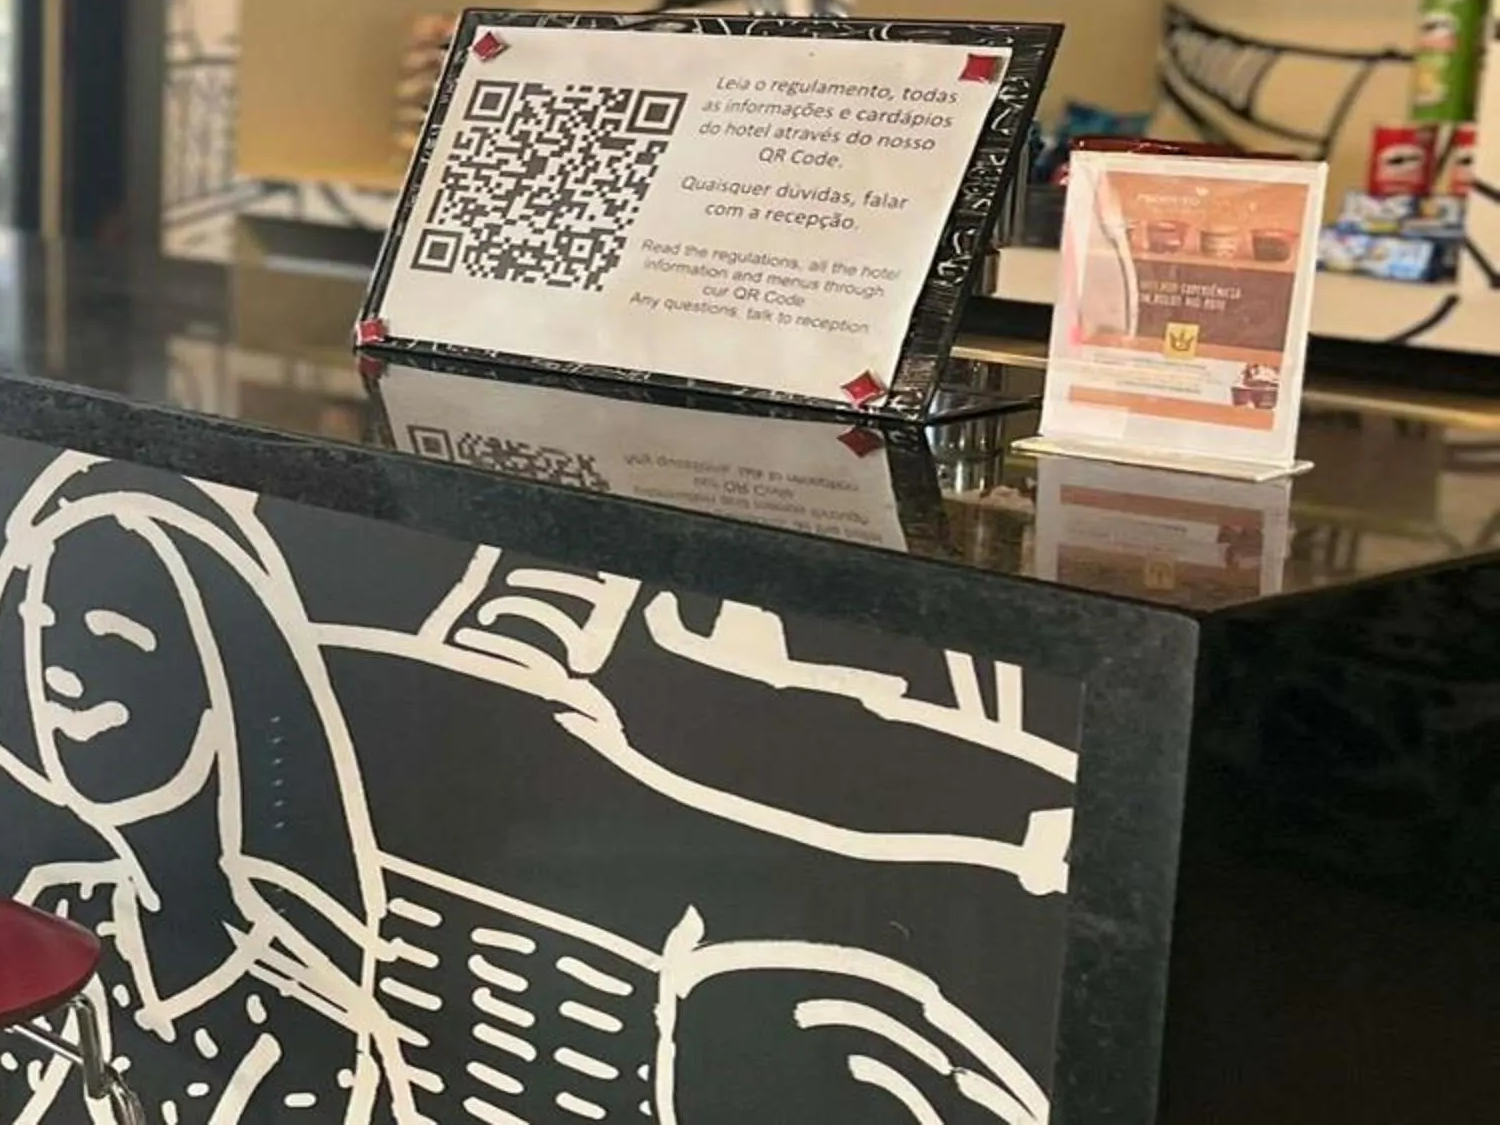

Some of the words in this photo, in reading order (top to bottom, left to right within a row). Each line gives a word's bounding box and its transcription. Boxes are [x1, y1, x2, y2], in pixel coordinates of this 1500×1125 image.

[716, 77, 749, 91] Leia
[755, 80, 765, 91] o
[770, 78, 894, 101] regulamento,
[901, 83, 958, 104] todas
[701, 99, 721, 112] as
[725, 97, 834, 120] informações
[839, 108, 851, 120] e
[855, 105, 954, 129] cardápios
[699, 121, 720, 135] do
[724, 122, 771, 138] hotel
[774, 124, 840, 144] através
[845, 128, 872, 146] do
[877, 135, 936, 151] nosso
[758, 147, 785, 164] QR
[790, 149, 843, 168] Code.
[681, 175, 772, 196] Quaisquer
[862, 190, 909, 209] falar
[705, 203, 743, 217] com
[749, 207, 760, 219] a
[765, 209, 859, 230] recepção.
[642, 238, 679, 255] Read
[683, 244, 708, 258] the
[808, 260, 828, 273] all
[832, 262, 857, 276] the
[644, 258, 728, 278] information
[732, 269, 763, 284] and
[766, 274, 819, 290] menus
[823, 279, 884, 299] through
[702, 286, 729, 297] our
[733, 286, 760, 301] QR
[629, 291, 660, 309] Any
[746, 307, 773, 322] talk
[778, 312, 793, 324] to
